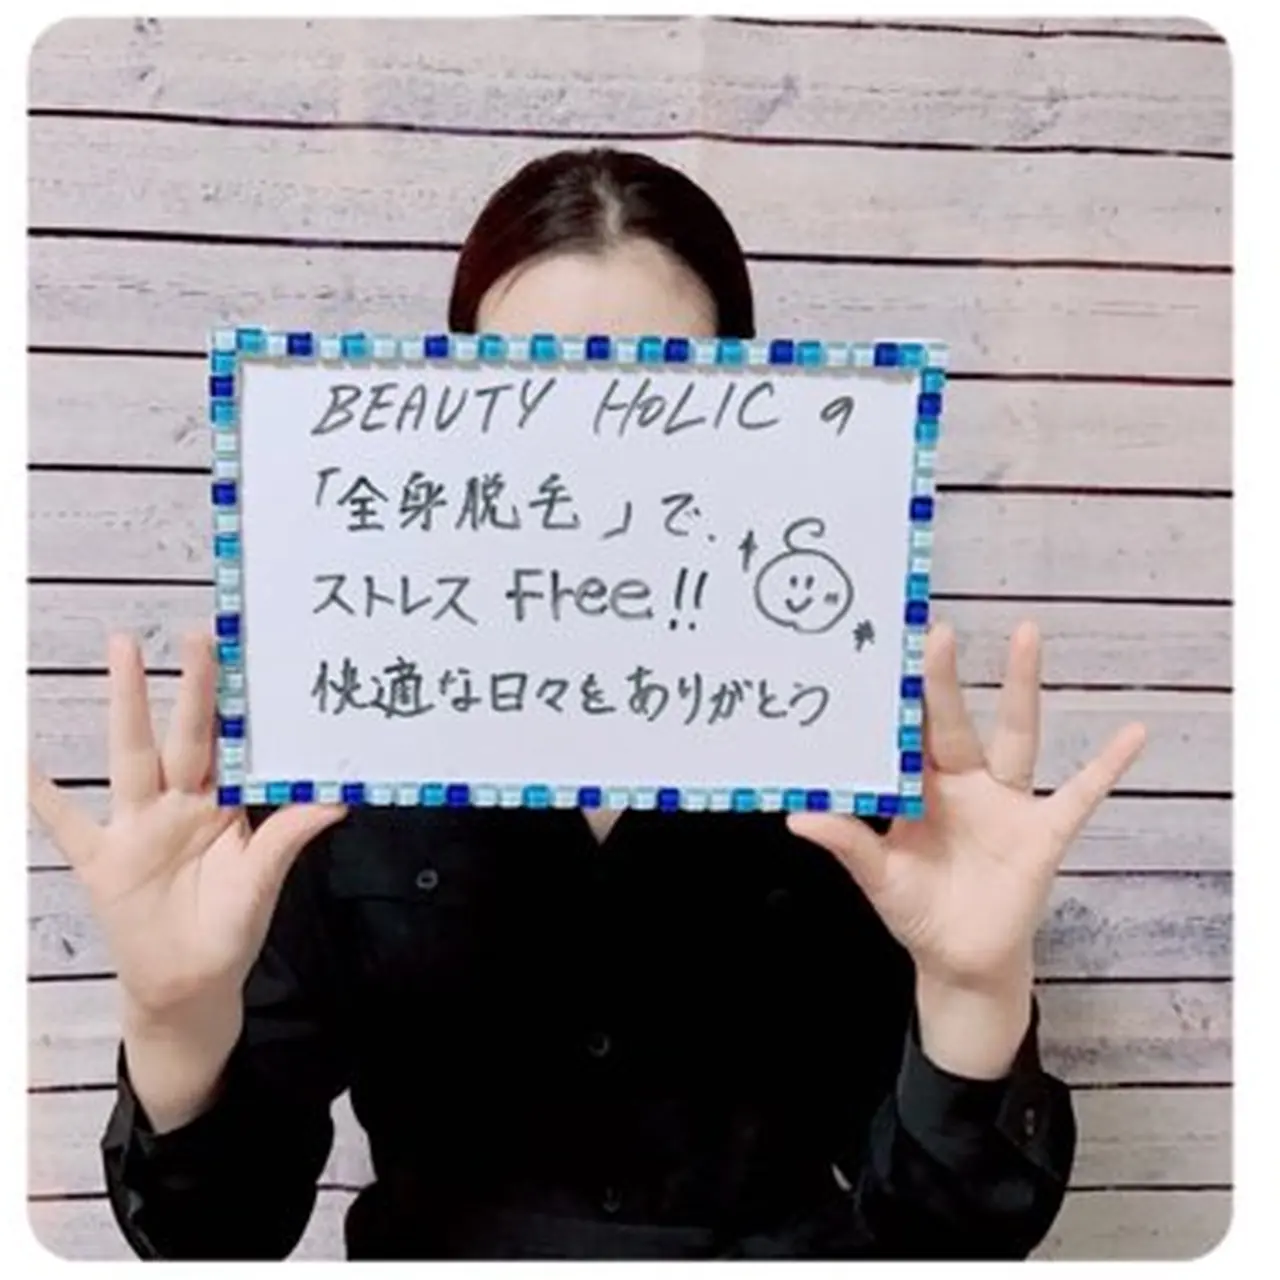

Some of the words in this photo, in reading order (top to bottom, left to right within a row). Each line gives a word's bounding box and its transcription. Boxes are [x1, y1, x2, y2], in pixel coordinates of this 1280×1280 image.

[310, 367, 557, 436] BEAUTY
[313, 574, 477, 625] ストレス
[311, 655, 829, 727] 快適な日々をありがとう
